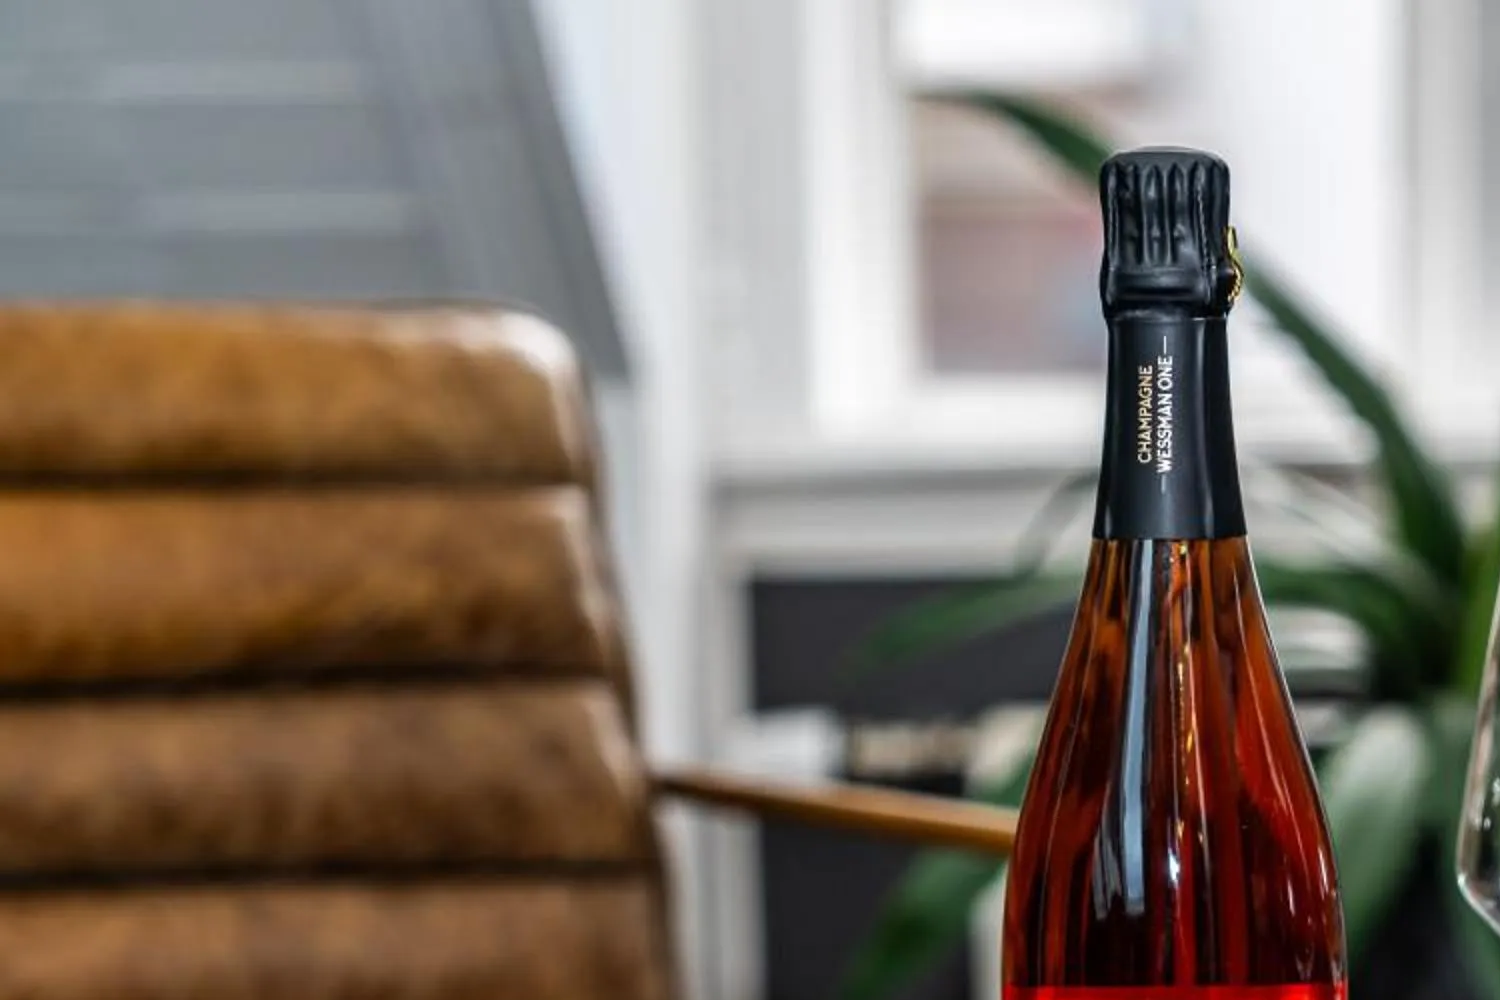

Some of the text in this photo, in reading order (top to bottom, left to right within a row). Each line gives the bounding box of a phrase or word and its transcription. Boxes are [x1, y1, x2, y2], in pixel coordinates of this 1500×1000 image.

[1138, 365, 1153, 463] CHAMPAGNE
[1157, 355, 1173, 473] WESSMAN ONE
